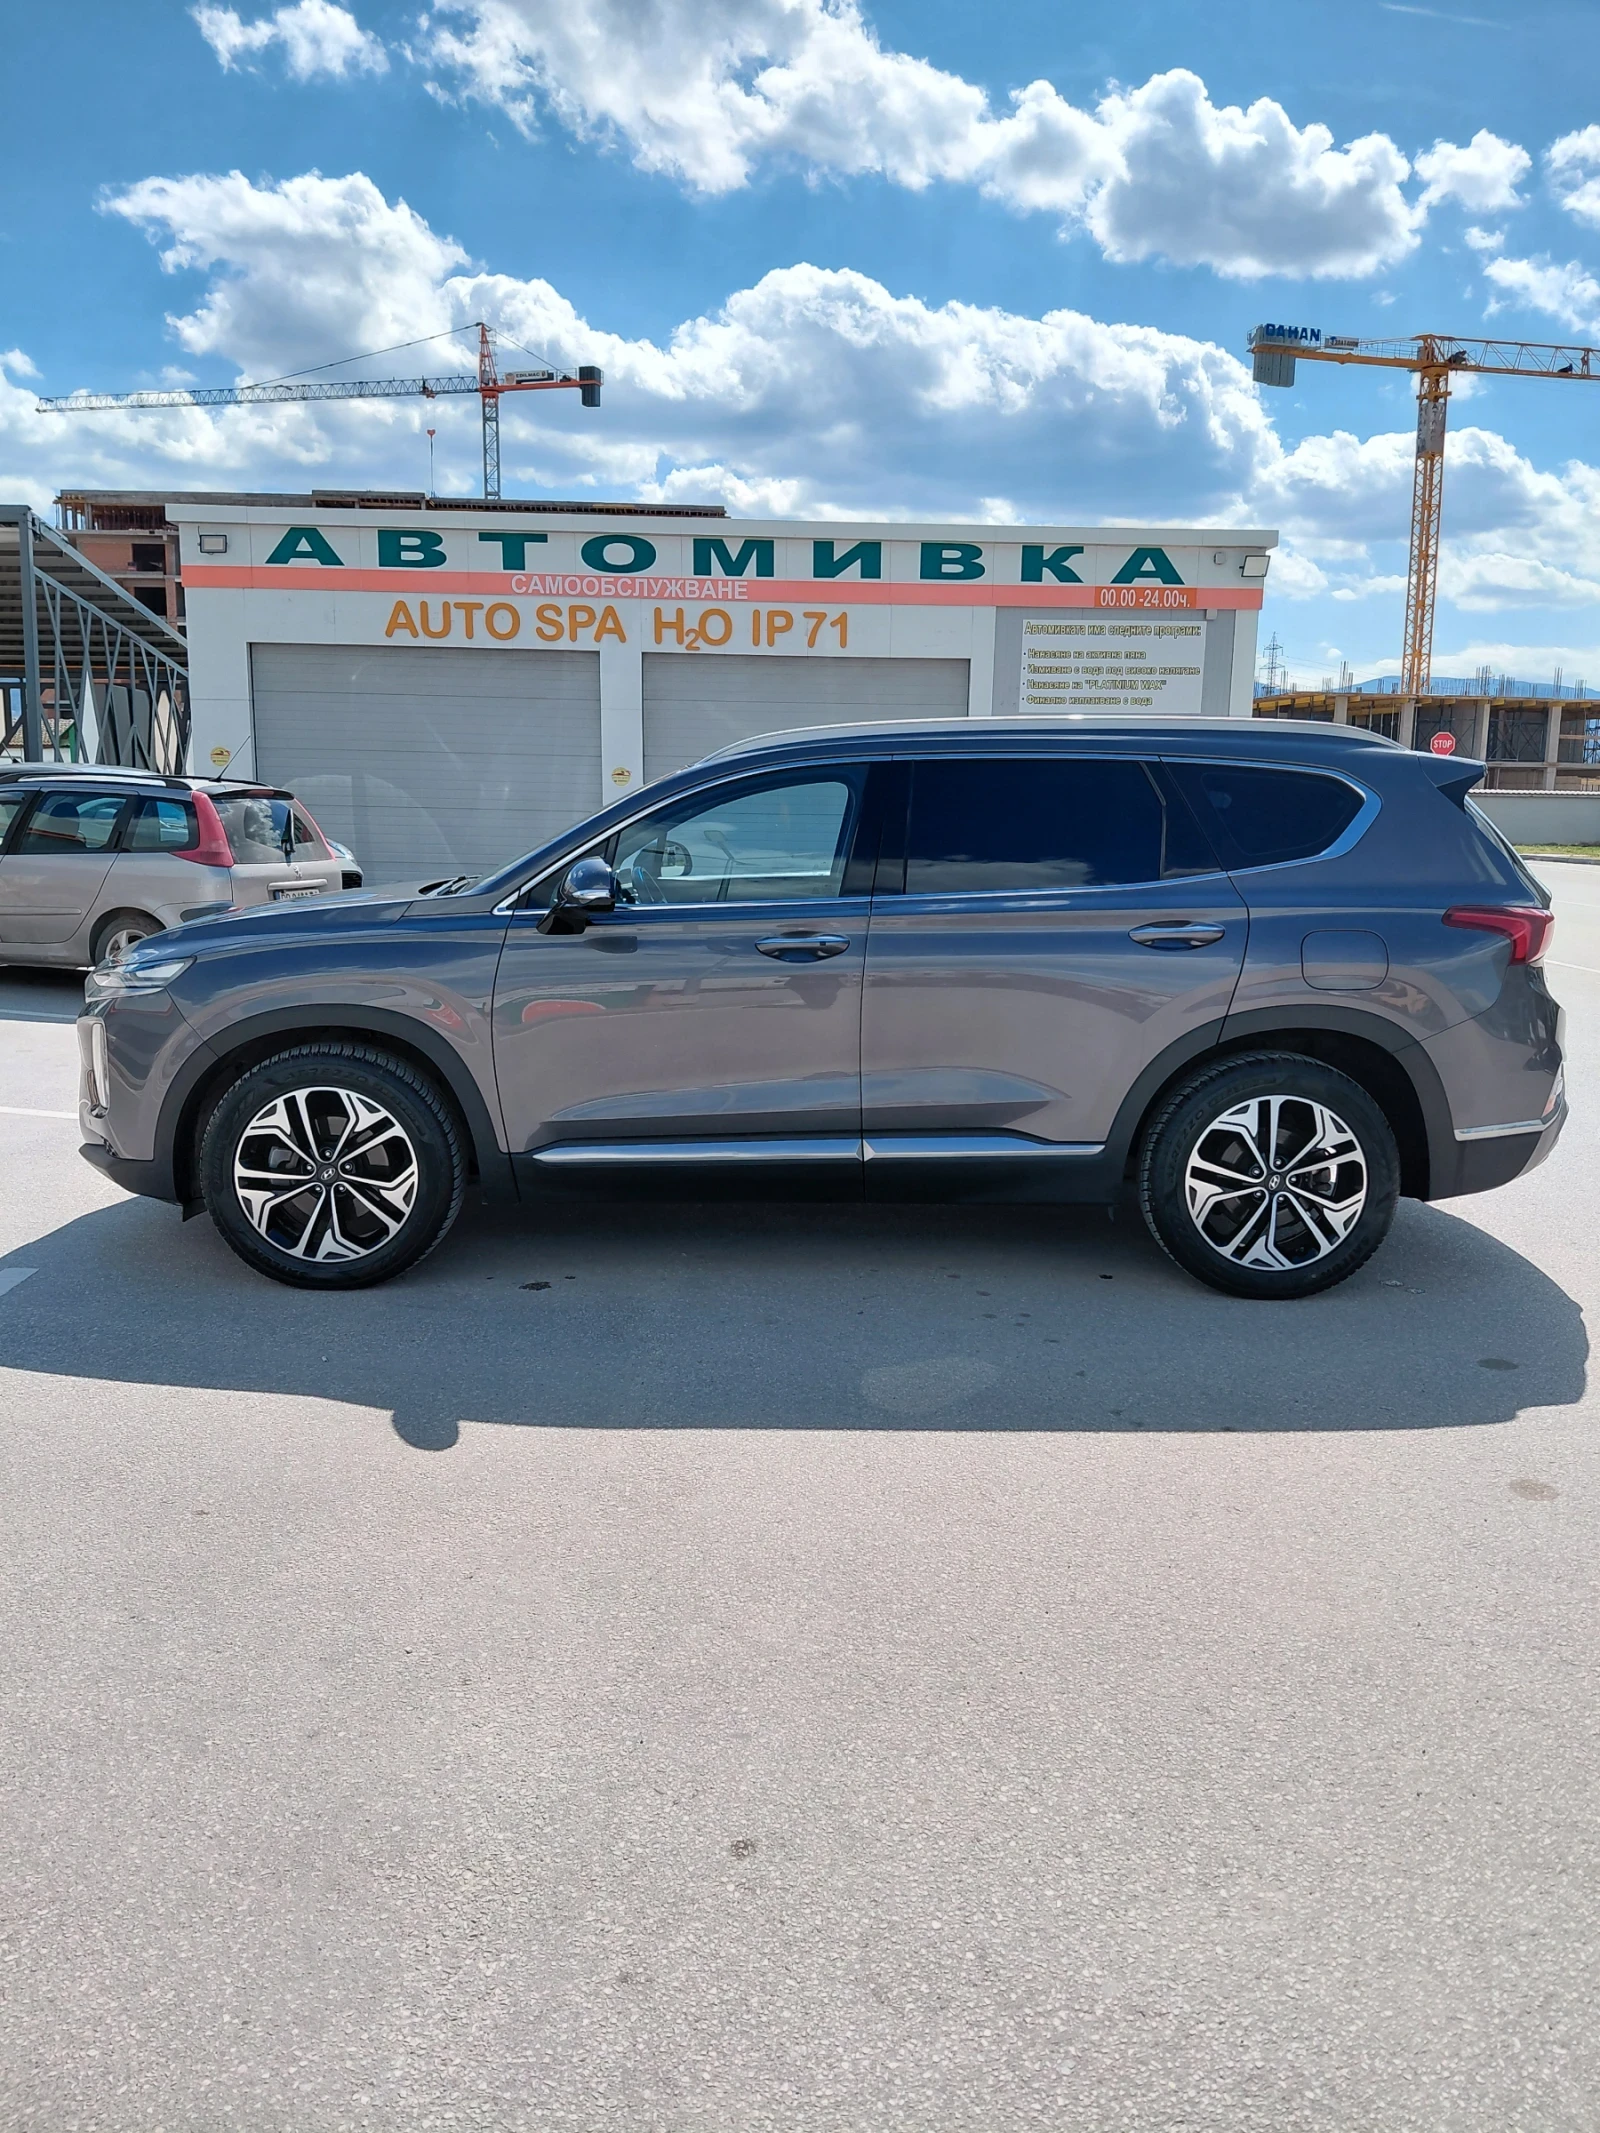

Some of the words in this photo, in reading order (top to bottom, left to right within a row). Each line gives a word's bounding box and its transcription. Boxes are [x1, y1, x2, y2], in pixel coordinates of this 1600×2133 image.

[1265, 323, 1321, 341] DAHAN
[265, 526, 1186, 586] АВТОМИВКА
[511, 574, 748, 600] САМООБСЛУЖВАНЕ
[385, 600, 521, 641] AUTO
[535, 603, 627, 643] SPA
[752, 609, 794, 647] IP
[802, 611, 848, 649] 71
[1024, 621, 1086, 635] Автомивката
[1087, 624, 1106, 636] има
[1108, 625, 1152, 637] следните
[1153, 625, 1202, 639] програми:
[1027, 648, 1071, 659] Нанасяне
[1073, 651, 1084, 659] на
[1086, 651, 1122, 660] активна
[1027, 664, 1072, 675] Измиване
[1081, 666, 1104, 676] вода
[1105, 666, 1123, 676] под
[1124, 666, 1157, 675] високо
[1026, 679, 1070, 690] Нанасяне
[1072, 682, 1083, 690] на
[1026, 694, 1067, 704] Финално
[1068, 697, 1121, 705] изплакване
[1130, 697, 1153, 707] вода
[1433, 740, 1453, 749] STOP
